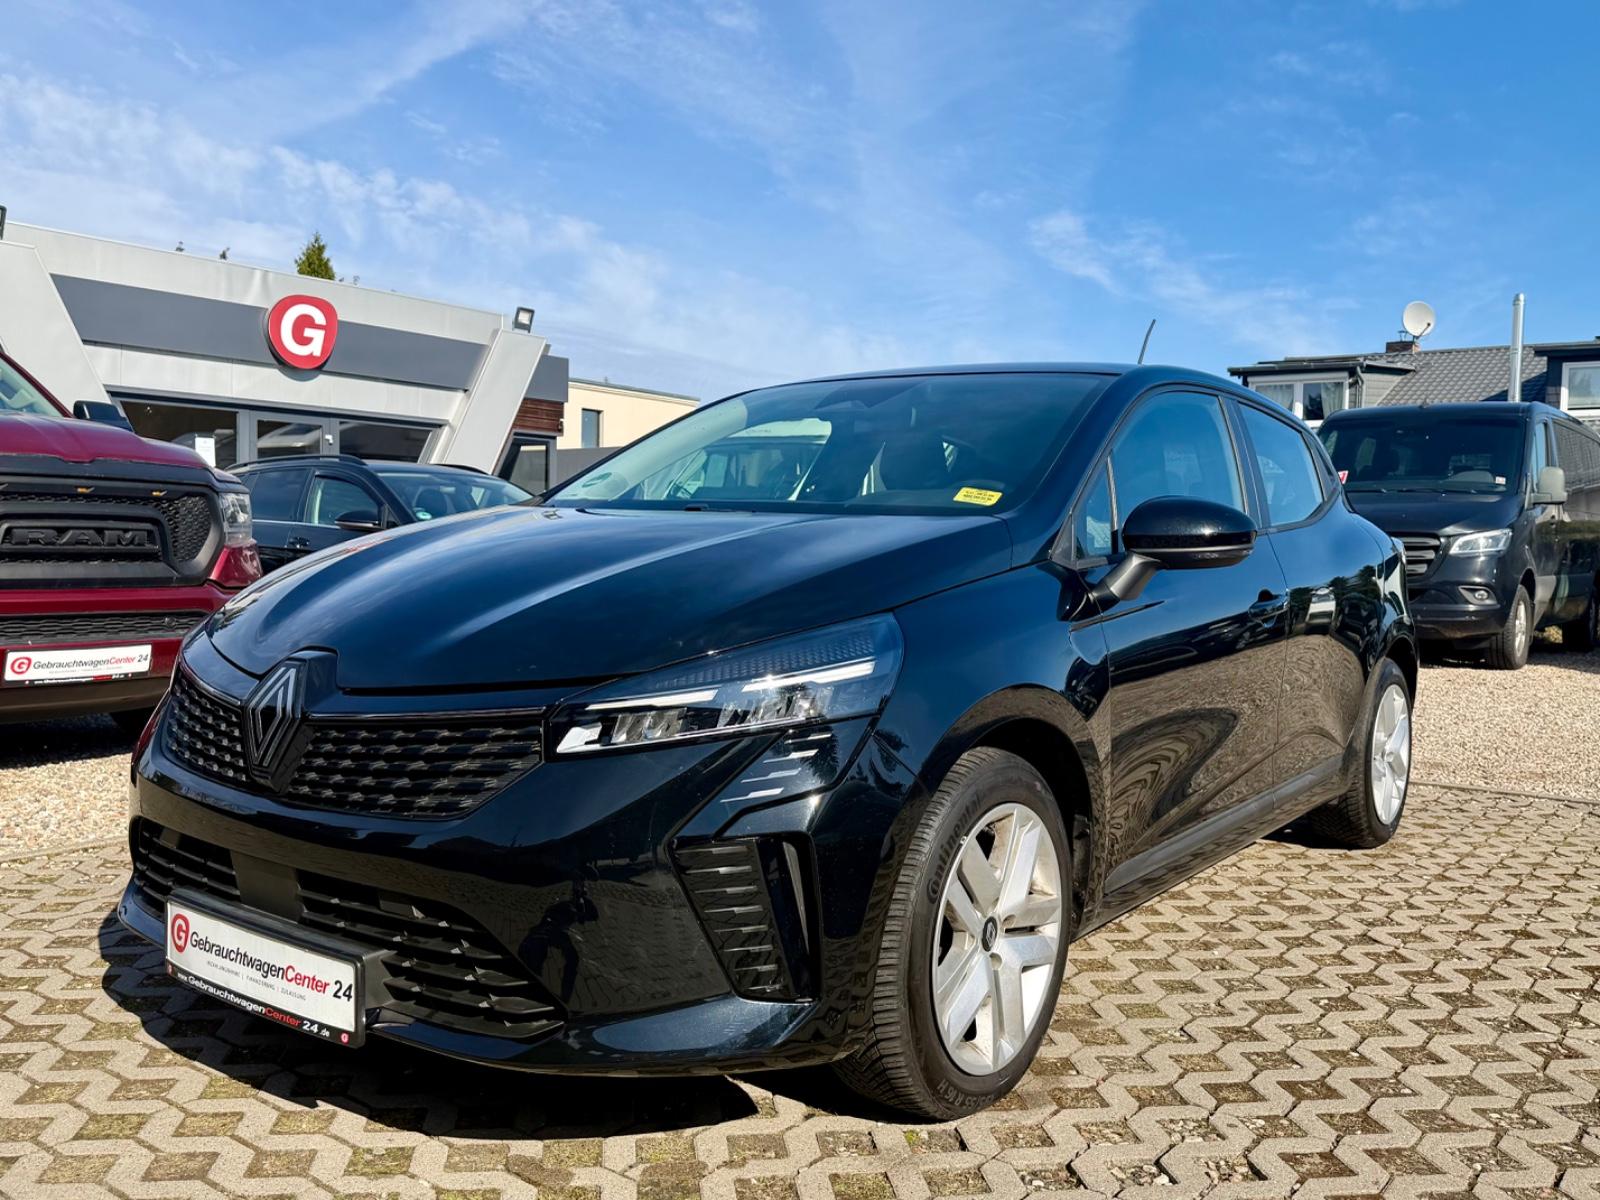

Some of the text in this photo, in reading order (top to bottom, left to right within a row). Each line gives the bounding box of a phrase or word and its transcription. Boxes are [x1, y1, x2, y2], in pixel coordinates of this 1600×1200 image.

[281, 304, 326, 357] G
[11, 528, 148, 546] RAM
[33, 656, 136, 669] GebrauchtwagenCenter
[137, 653, 149, 663] 24
[190, 931, 330, 994] GebrauchtwagenCenter
[333, 980, 353, 1002] 24
[302, 1021, 318, 1033] 24
